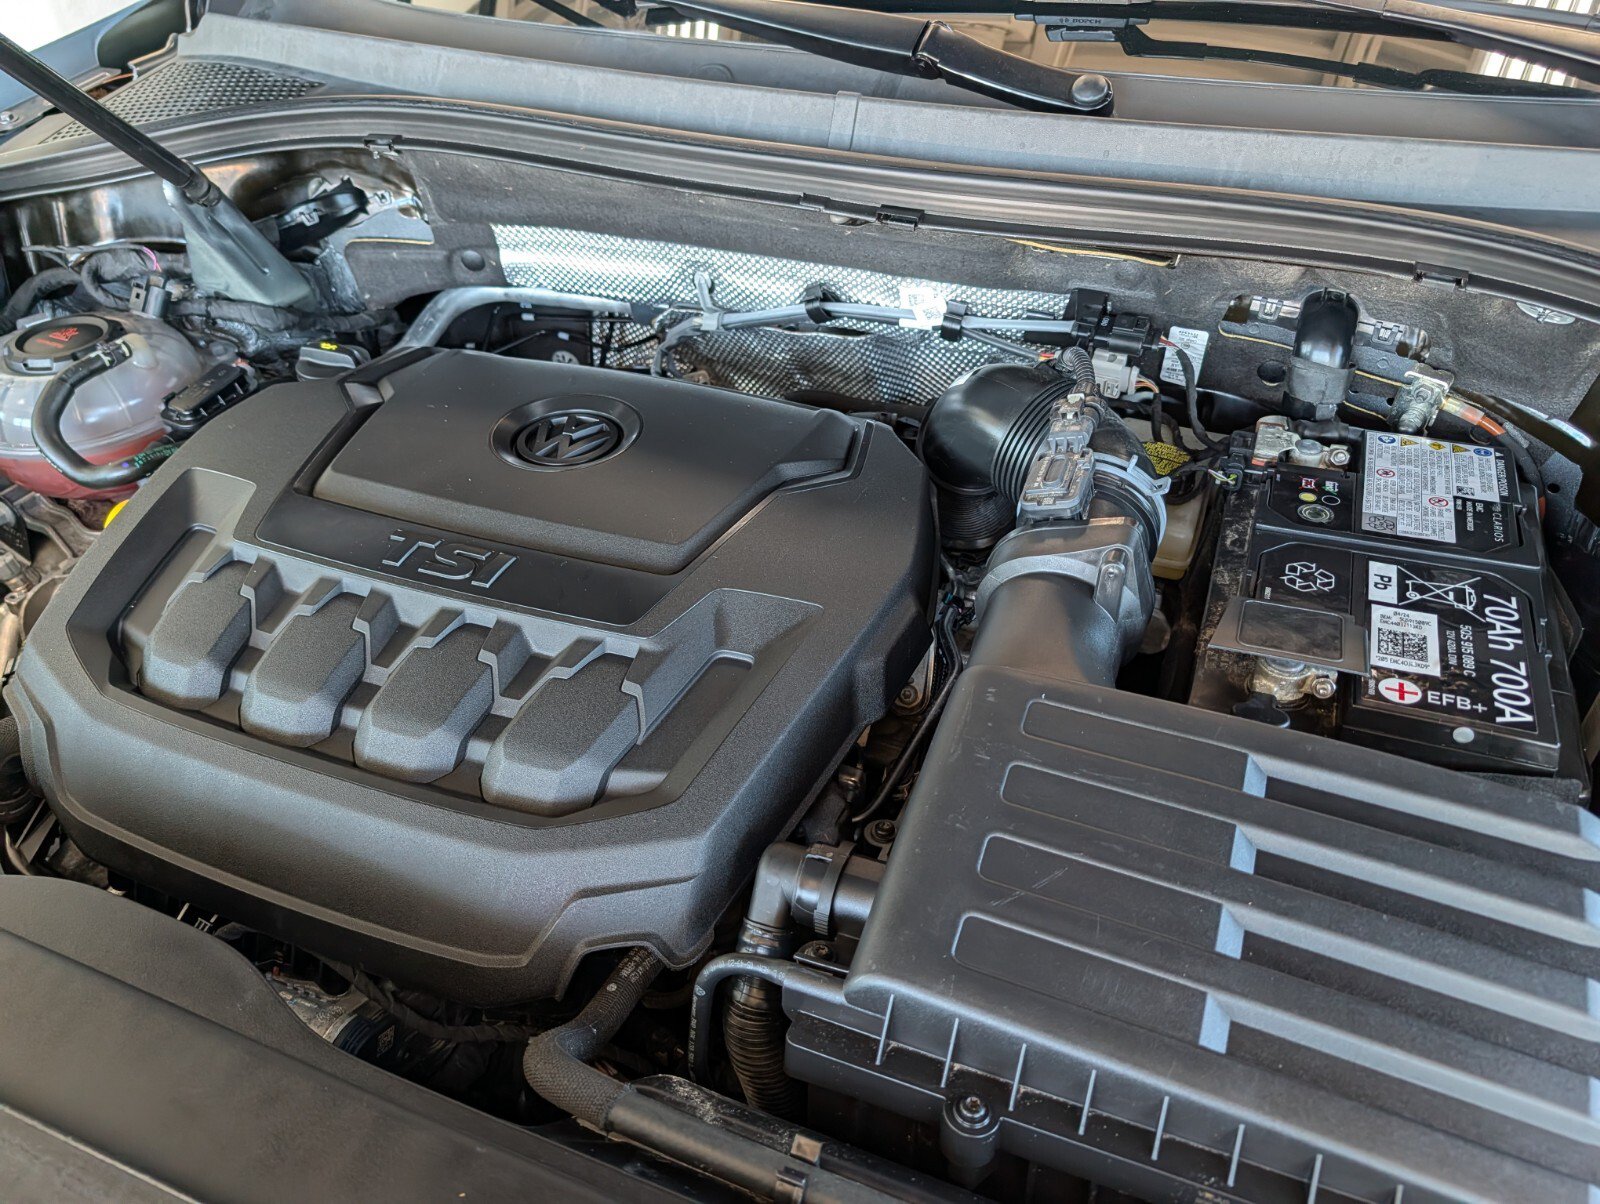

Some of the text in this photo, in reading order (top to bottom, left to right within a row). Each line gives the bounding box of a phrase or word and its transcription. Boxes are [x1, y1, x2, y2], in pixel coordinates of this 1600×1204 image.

[1492, 512, 1504, 543] CLARIOS
[382, 529, 520, 588] TSI
[1373, 573, 1392, 591] Pb
[1460, 624, 1476, 677] 5QS 915 089 C
[1483, 594, 1534, 723] 70Ah 700A
[1427, 690, 1488, 713] EFB+
